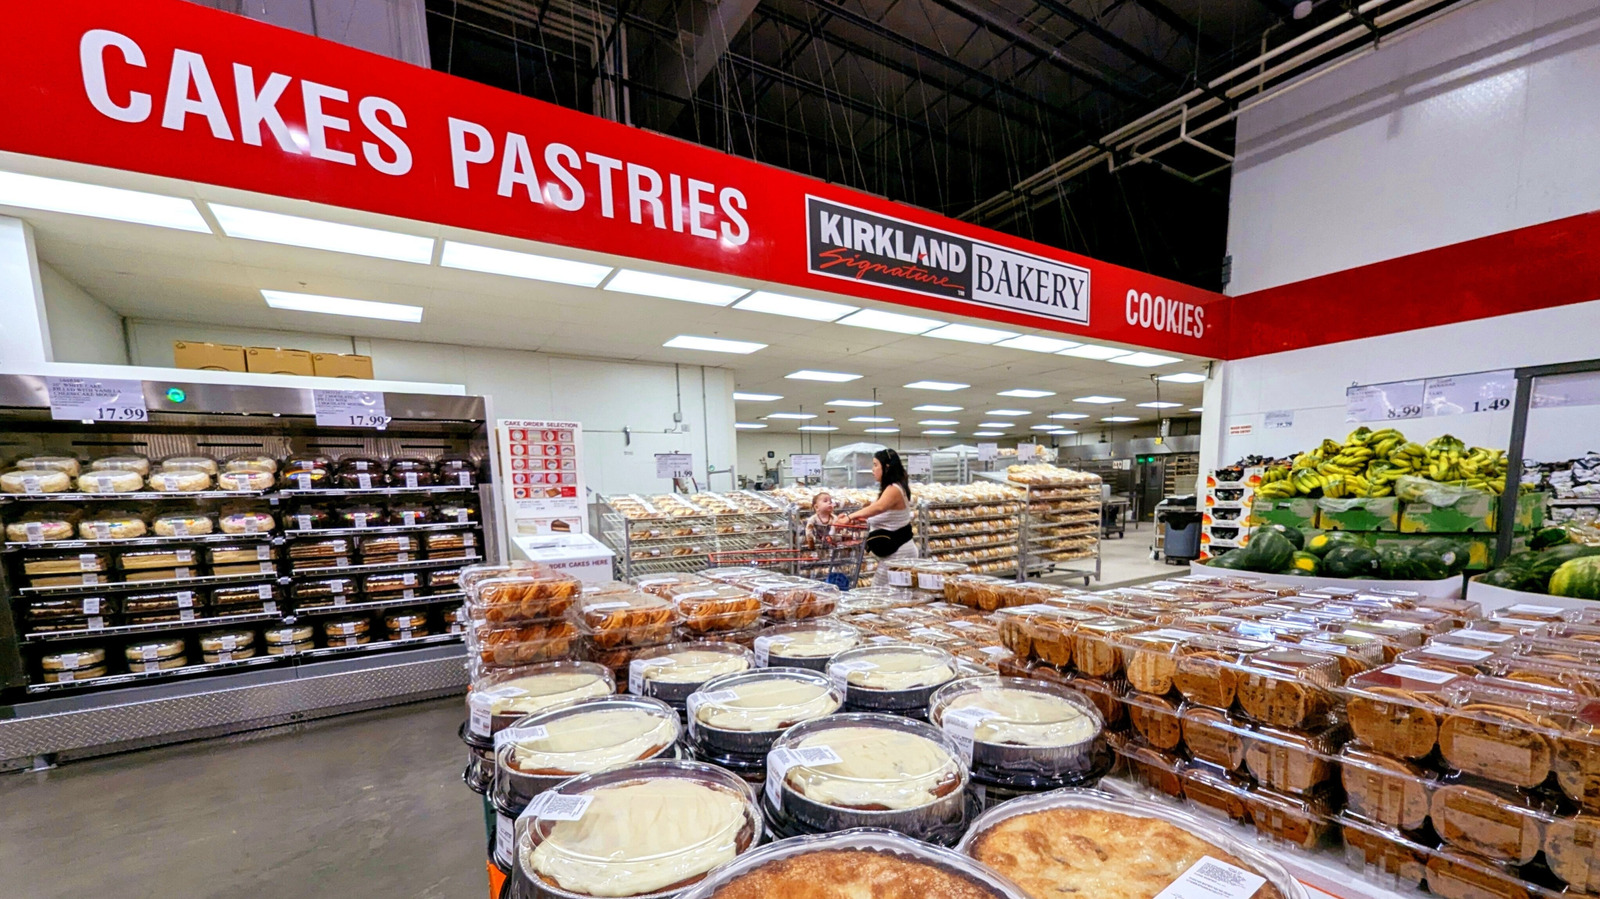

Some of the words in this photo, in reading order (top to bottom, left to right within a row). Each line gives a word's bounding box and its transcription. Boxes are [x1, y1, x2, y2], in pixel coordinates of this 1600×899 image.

[78, 28, 413, 176] CAKES
[448, 116, 750, 247] PASTRIES
[819, 210, 967, 273] KIRKLAND
[818, 247, 965, 289] Signature
[975, 253, 1085, 312] BAKERY
[1125, 288, 1204, 339] COOKIES
[1387, 405, 1421, 418] 8.99
[1473, 398, 1510, 412] 1.49
[97, 407, 145, 420] 17.99
[349, 415, 384, 426] 17.99
[673, 470, 693, 478] 11.99
[548, 562, 566, 570] RDER
